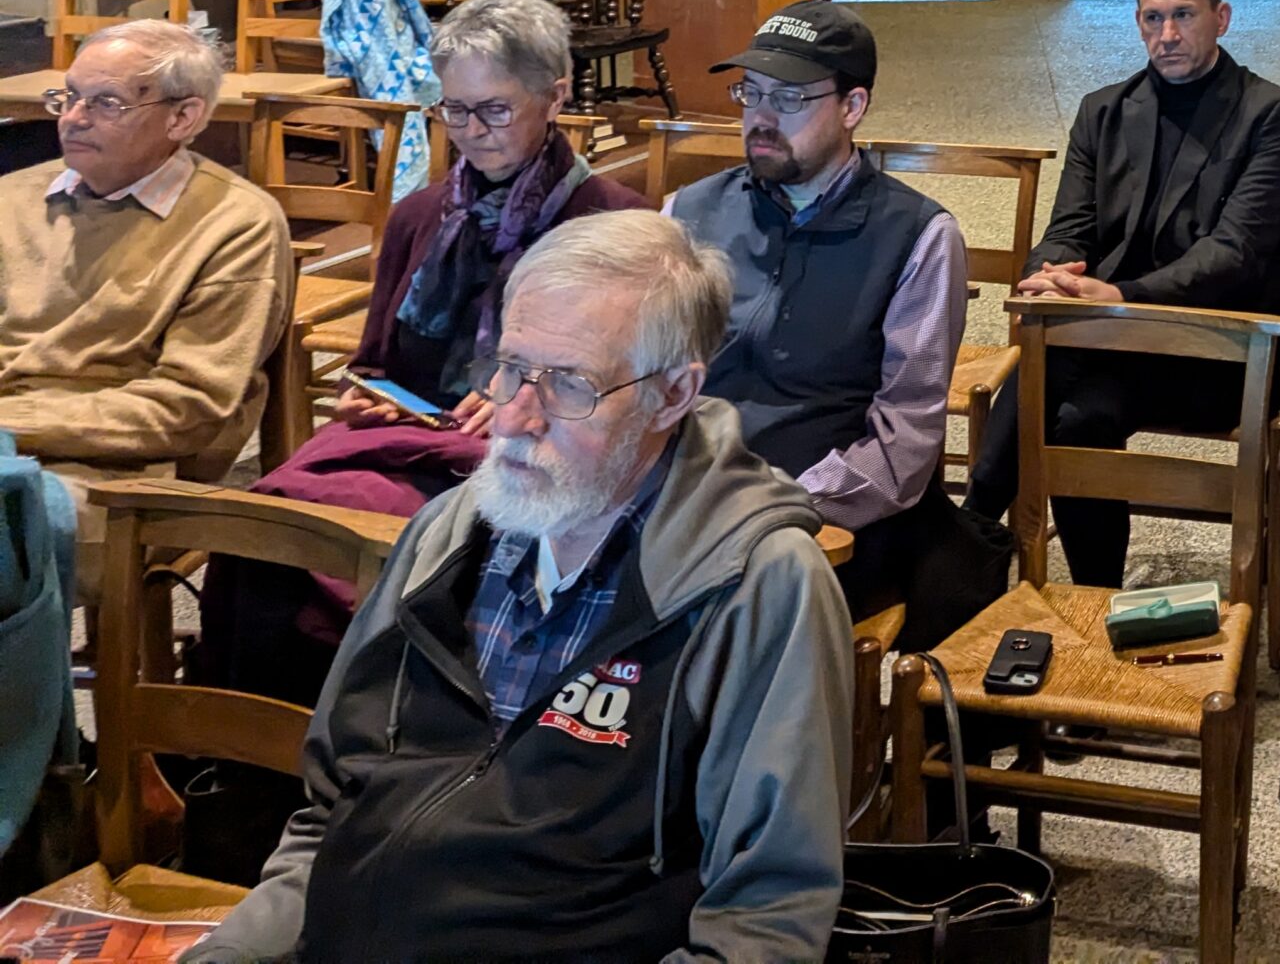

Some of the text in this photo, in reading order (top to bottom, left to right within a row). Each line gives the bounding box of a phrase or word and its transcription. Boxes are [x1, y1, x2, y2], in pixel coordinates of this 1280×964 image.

[778, 23, 818, 43] SOUND
[801, 21, 812, 29] OF
[552, 672, 630, 727] 50
